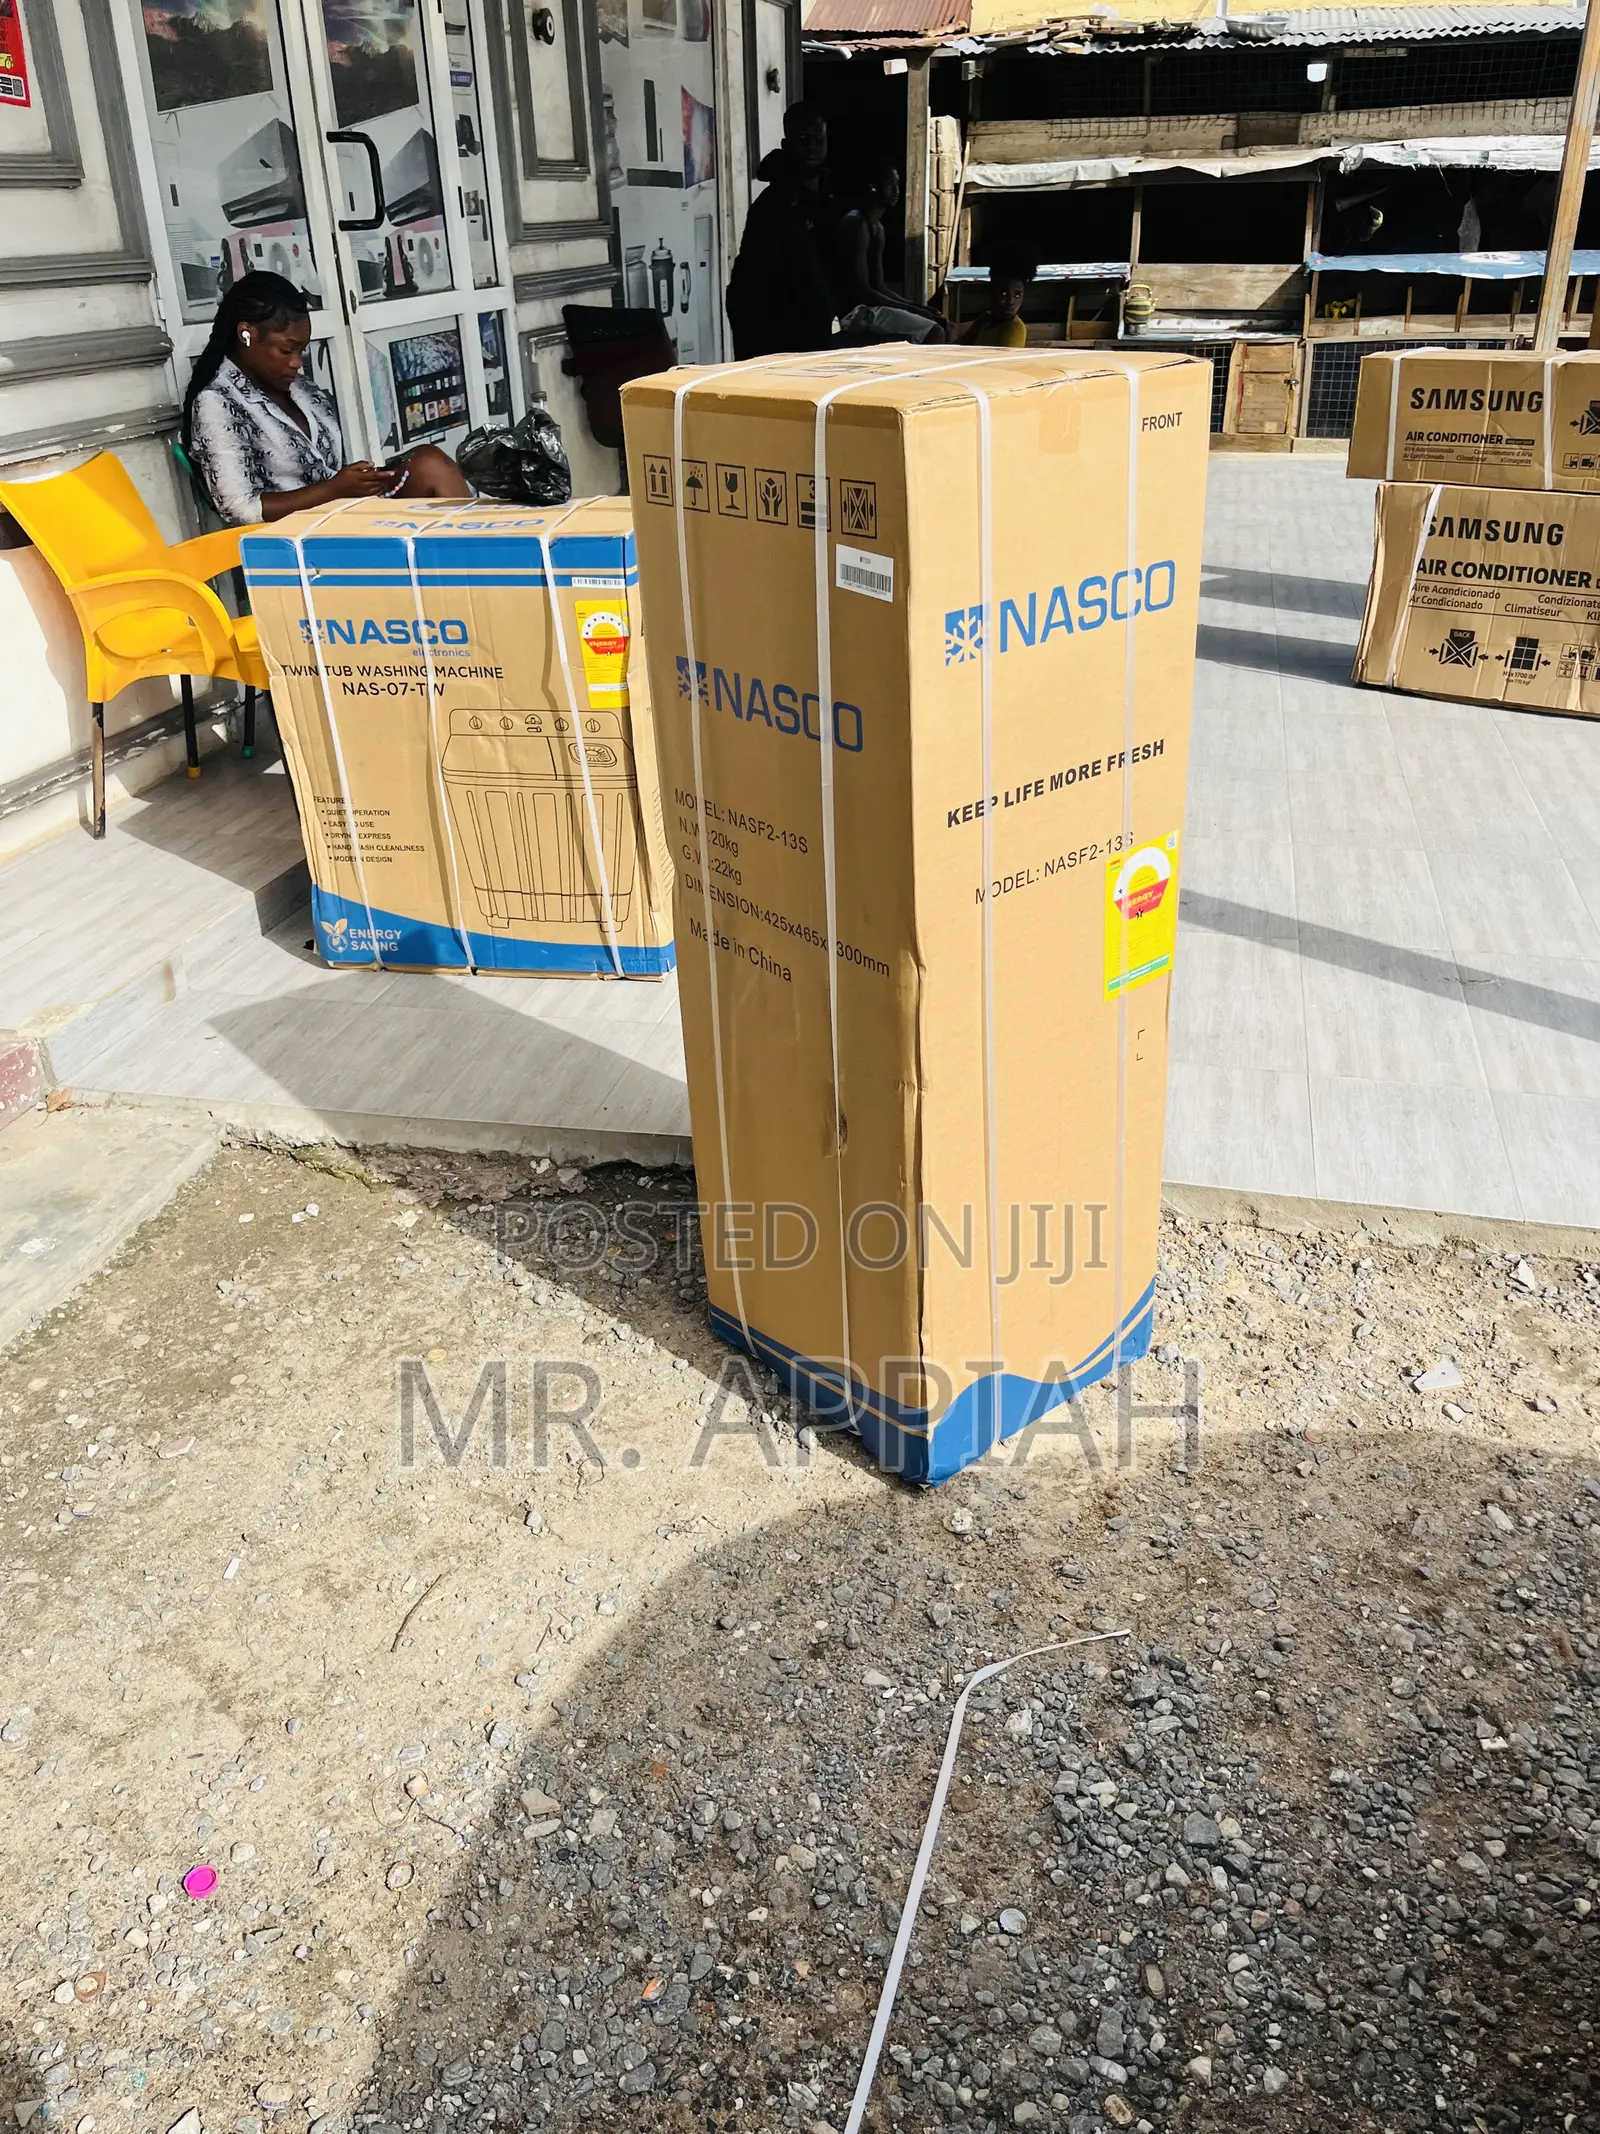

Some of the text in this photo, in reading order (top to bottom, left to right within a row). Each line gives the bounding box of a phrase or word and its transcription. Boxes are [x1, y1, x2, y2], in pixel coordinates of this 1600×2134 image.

[1410, 387, 1544, 413] SAMSUNG
[1142, 412, 1183, 432] FRONT
[1405, 431, 1503, 445] AIR CONDITIONER
[395, 518, 545, 531] NASCO
[1417, 558, 1592, 589] AIR CONDITIONER
[1431, 585, 1501, 600] Acondicionado
[1000, 559, 1176, 654] NASCO
[1421, 595, 1483, 610] Condicionado
[1504, 603, 1562, 617] Climatiseur
[326, 619, 469, 645] NASCO
[1453, 631, 1471, 639] BACK
[281, 664, 504, 679] TWIN TUB WASHING MACHINE
[342, 682, 445, 697] NAS-07-TW
[714, 667, 863, 753] NASCO
[947, 739, 1165, 828] KEEP LIFE MORE FRESH
[328, 820, 347, 828] EASY
[675, 788, 808, 854] MOEL: NASF2-13S
[330, 832, 392, 840] DRYIN EXPRESS
[376, 844, 425, 852] CLEANLINESS
[975, 831, 1134, 905] MODEL: NASF2-13S
[349, 928, 402, 940] ENERGY
[733, 937, 745, 959] in
[748, 946, 792, 983] China
